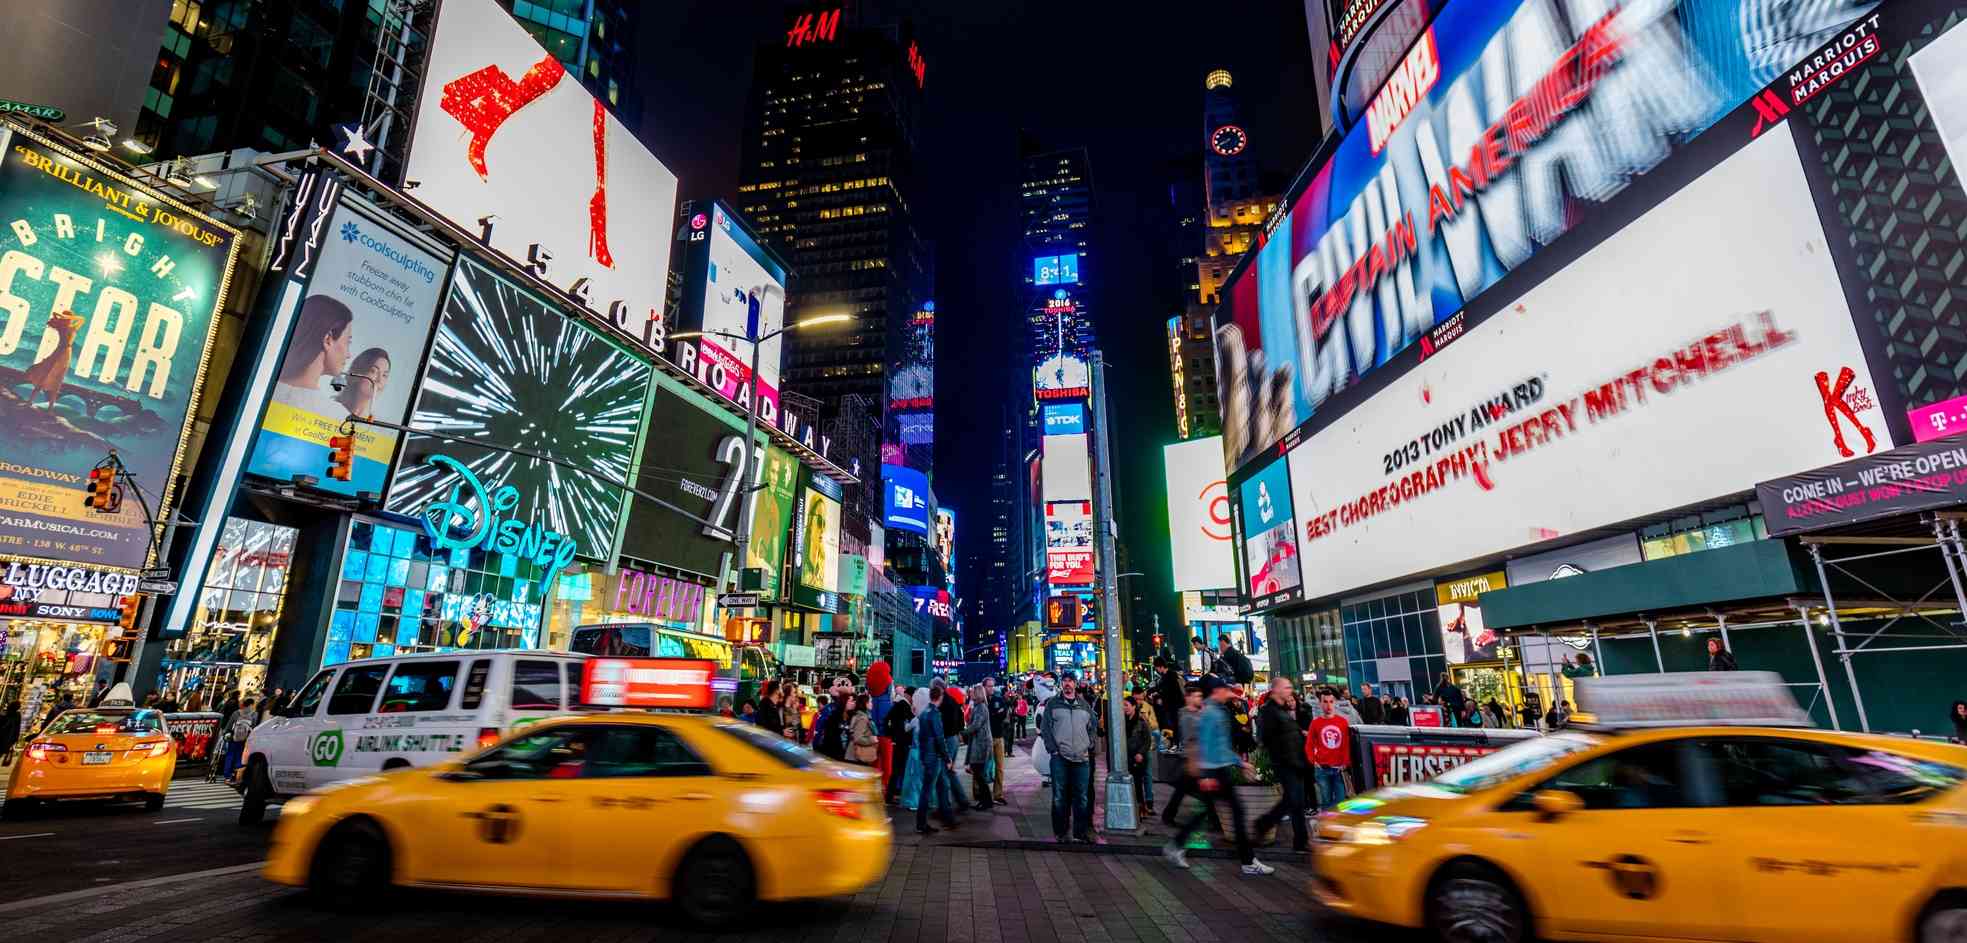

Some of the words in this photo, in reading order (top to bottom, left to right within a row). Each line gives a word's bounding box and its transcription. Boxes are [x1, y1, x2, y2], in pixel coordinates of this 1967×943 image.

[787, 9, 840, 47] H&M
[1789, 14, 1881, 86] MARRIOTT
[1794, 39, 1877, 102] MARQUIS
[1368, 30, 1438, 155] MARVEL
[135, 203, 149, 217] &
[691, 230, 705, 241] LG
[10, 212, 199, 303] BRIGHT
[360, 231, 435, 284] coolsculpting
[361, 260, 389, 280] Freeze
[340, 284, 359, 297] with
[346, 271, 386, 294] stubborn
[0, 249, 184, 400] STAR
[1432, 311, 1465, 338] MARRIOTT
[1434, 325, 1464, 348] MARQUIS
[650, 320, 832, 459] BROADWAY
[1038, 389, 1088, 399] TOSHIBA
[1057, 415, 1081, 425] TDK
[1384, 440, 1420, 475] 2013
[1420, 414, 1466, 456] TONY
[1470, 376, 1545, 432] AWARD
[1783, 481, 1826, 504] COME
[1826, 477, 1844, 495] IN
[1916, 447, 1967, 474] OPEN
[17, 490, 55, 505] EDIE
[680, 477, 719, 501] FOREVER21.COM
[5, 561, 139, 596] LUGGAGE
[1449, 576, 1491, 600] INVICTA
[37, 604, 86, 617] SONY
[313, 735, 338, 760] GO
[355, 734, 402, 752] AIRLINK
[402, 734, 464, 752] SHUTTLE
